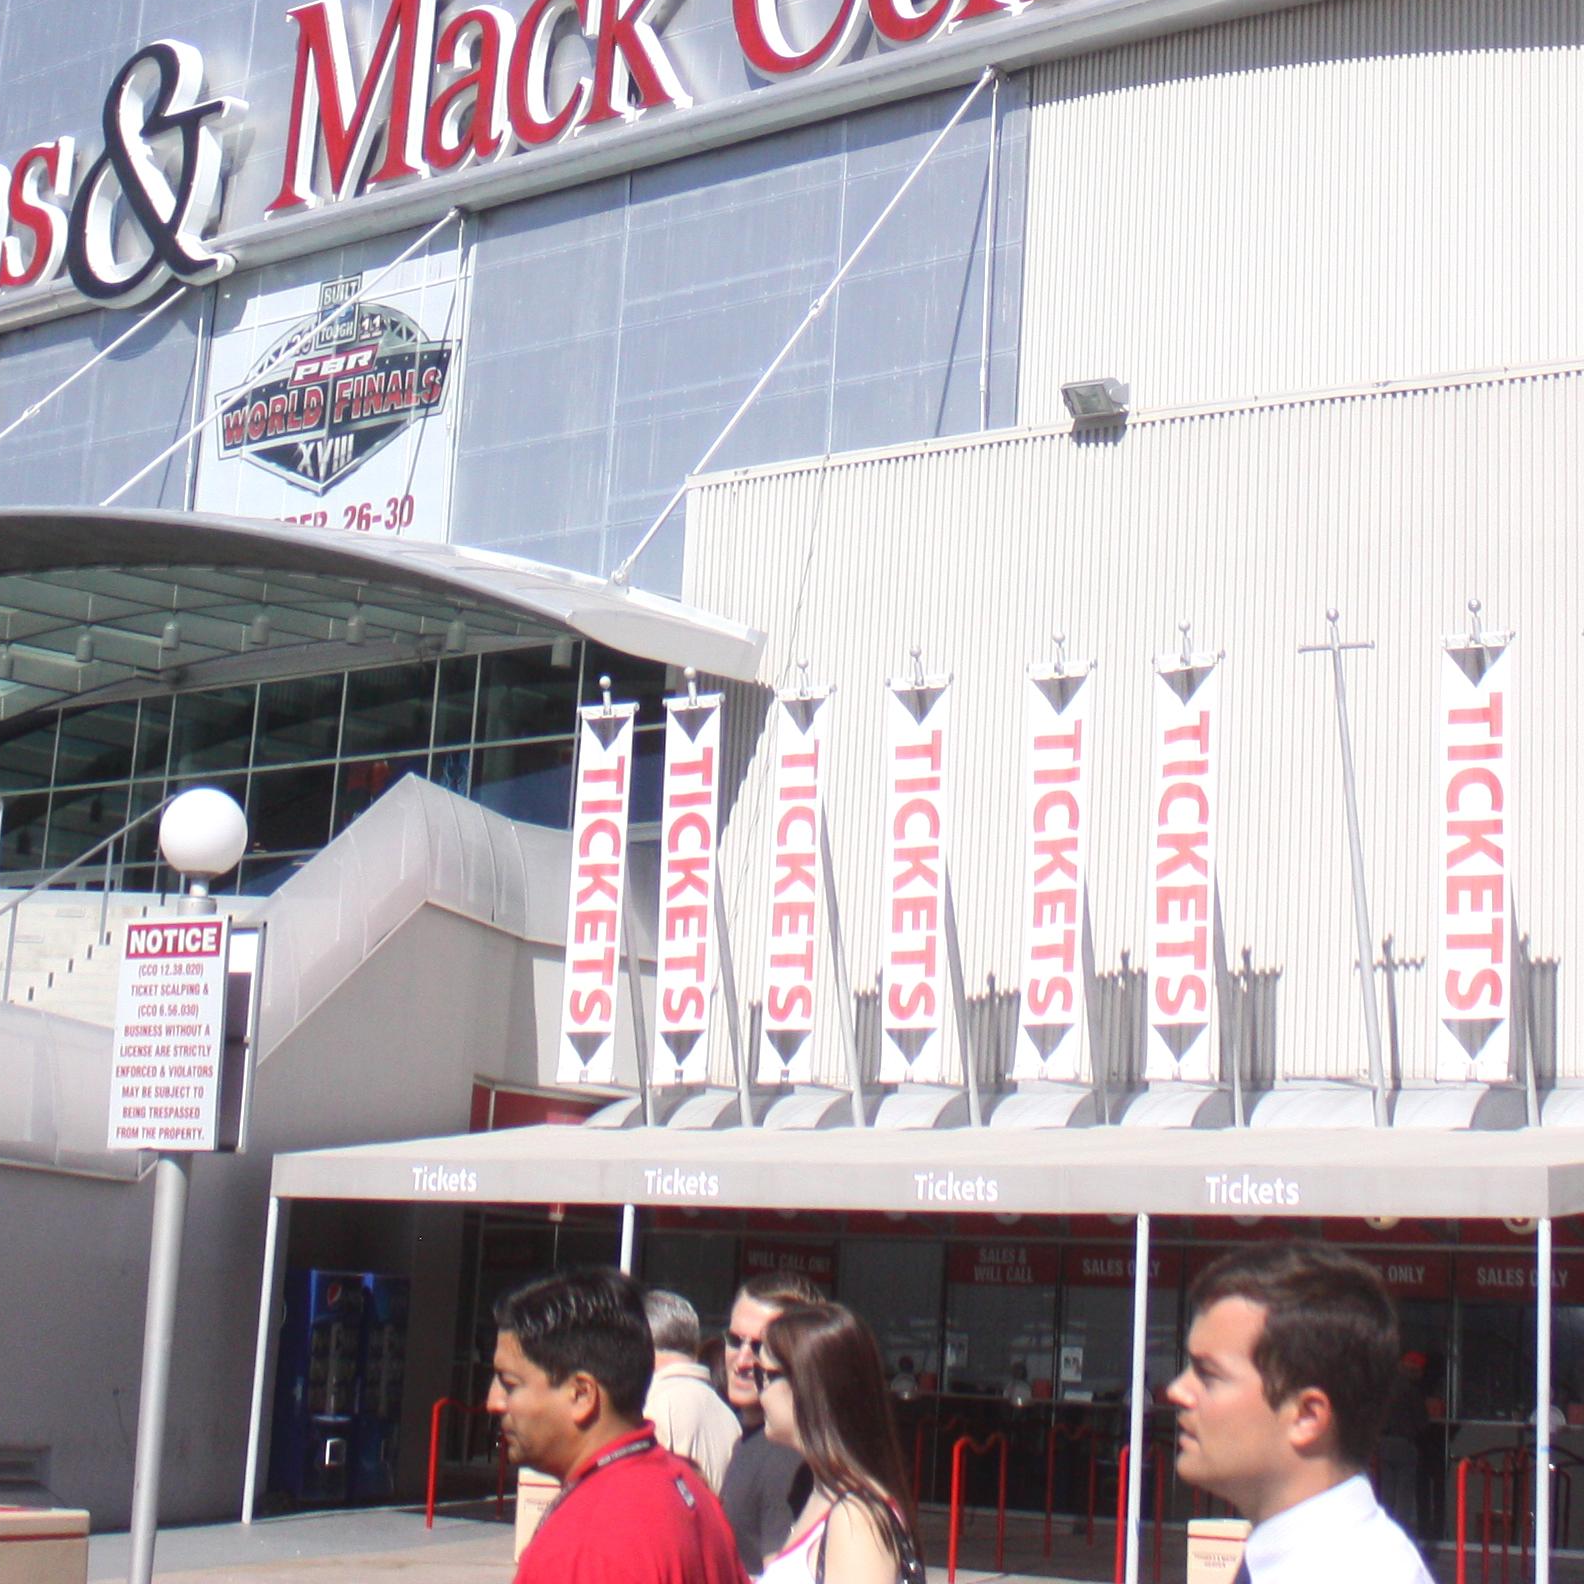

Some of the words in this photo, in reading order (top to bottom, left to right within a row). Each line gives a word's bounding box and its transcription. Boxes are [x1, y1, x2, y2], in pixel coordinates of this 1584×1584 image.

[68, 41, 248, 309] &
[324, 282, 357, 305] BUILT
[292, 348, 374, 382] PBR
[223, 385, 325, 446] WORLD
[334, 367, 443, 424] FINALS
[297, 433, 355, 482] XVIII
[343, 494, 415, 532] 26-30
[1155, 710, 1211, 1016] TICKETS
[1445, 692, 1504, 1011] TICKETS
[767, 738, 820, 1023] TICKETS
[888, 729, 942, 1021] TICKETS
[1027, 719, 1082, 1017] TICKETS
[569, 755, 626, 1024] TICKETS
[663, 746, 714, 1024] TICKETS
[129, 927, 217, 954] NOTICE
[131, 984, 158, 996] TICKET
[160, 983, 200, 996] SCALPING
[203, 983, 209, 995] &
[124, 1024, 163, 1037] BUSINESS
[165, 1024, 203, 1036] WITHOUT
[204, 1024, 211, 1036] A
[120, 1045, 153, 1057] LICENSE
[155, 1045, 171, 1057] ARE
[173, 1044, 212, 1057] STRICTLY
[116, 1065, 157, 1078] ENFORCED
[159, 1066, 166, 1077] &
[168, 1065, 214, 1078] VIOLATORS
[122, 1086, 140, 1098] MAY
[142, 1086, 152, 1098] BE
[154, 1086, 191, 1098] SUBJECT
[193, 1086, 204, 1098] TO
[122, 1107, 146, 1119] BEING
[149, 1107, 200, 1119] TRESPASSED
[116, 1127, 139, 1139] FROM
[142, 1127, 157, 1139] THE
[159, 1127, 205, 1141] PROPERTY.
[412, 1166, 477, 1192] Tickets
[644, 1168, 720, 1196] Tickets
[913, 1171, 999, 1202] Tickets
[1205, 1173, 1300, 1206] Tickets
[979, 1248, 1016, 1264] SALES
[1082, 1258, 1123, 1276] SALES
[974, 1265, 1002, 1282] WILL
[1006, 1267, 1034, 1283] CALL
[1388, 1266, 1426, 1285] ONLY
[1477, 1267, 1524, 1287] SALES
